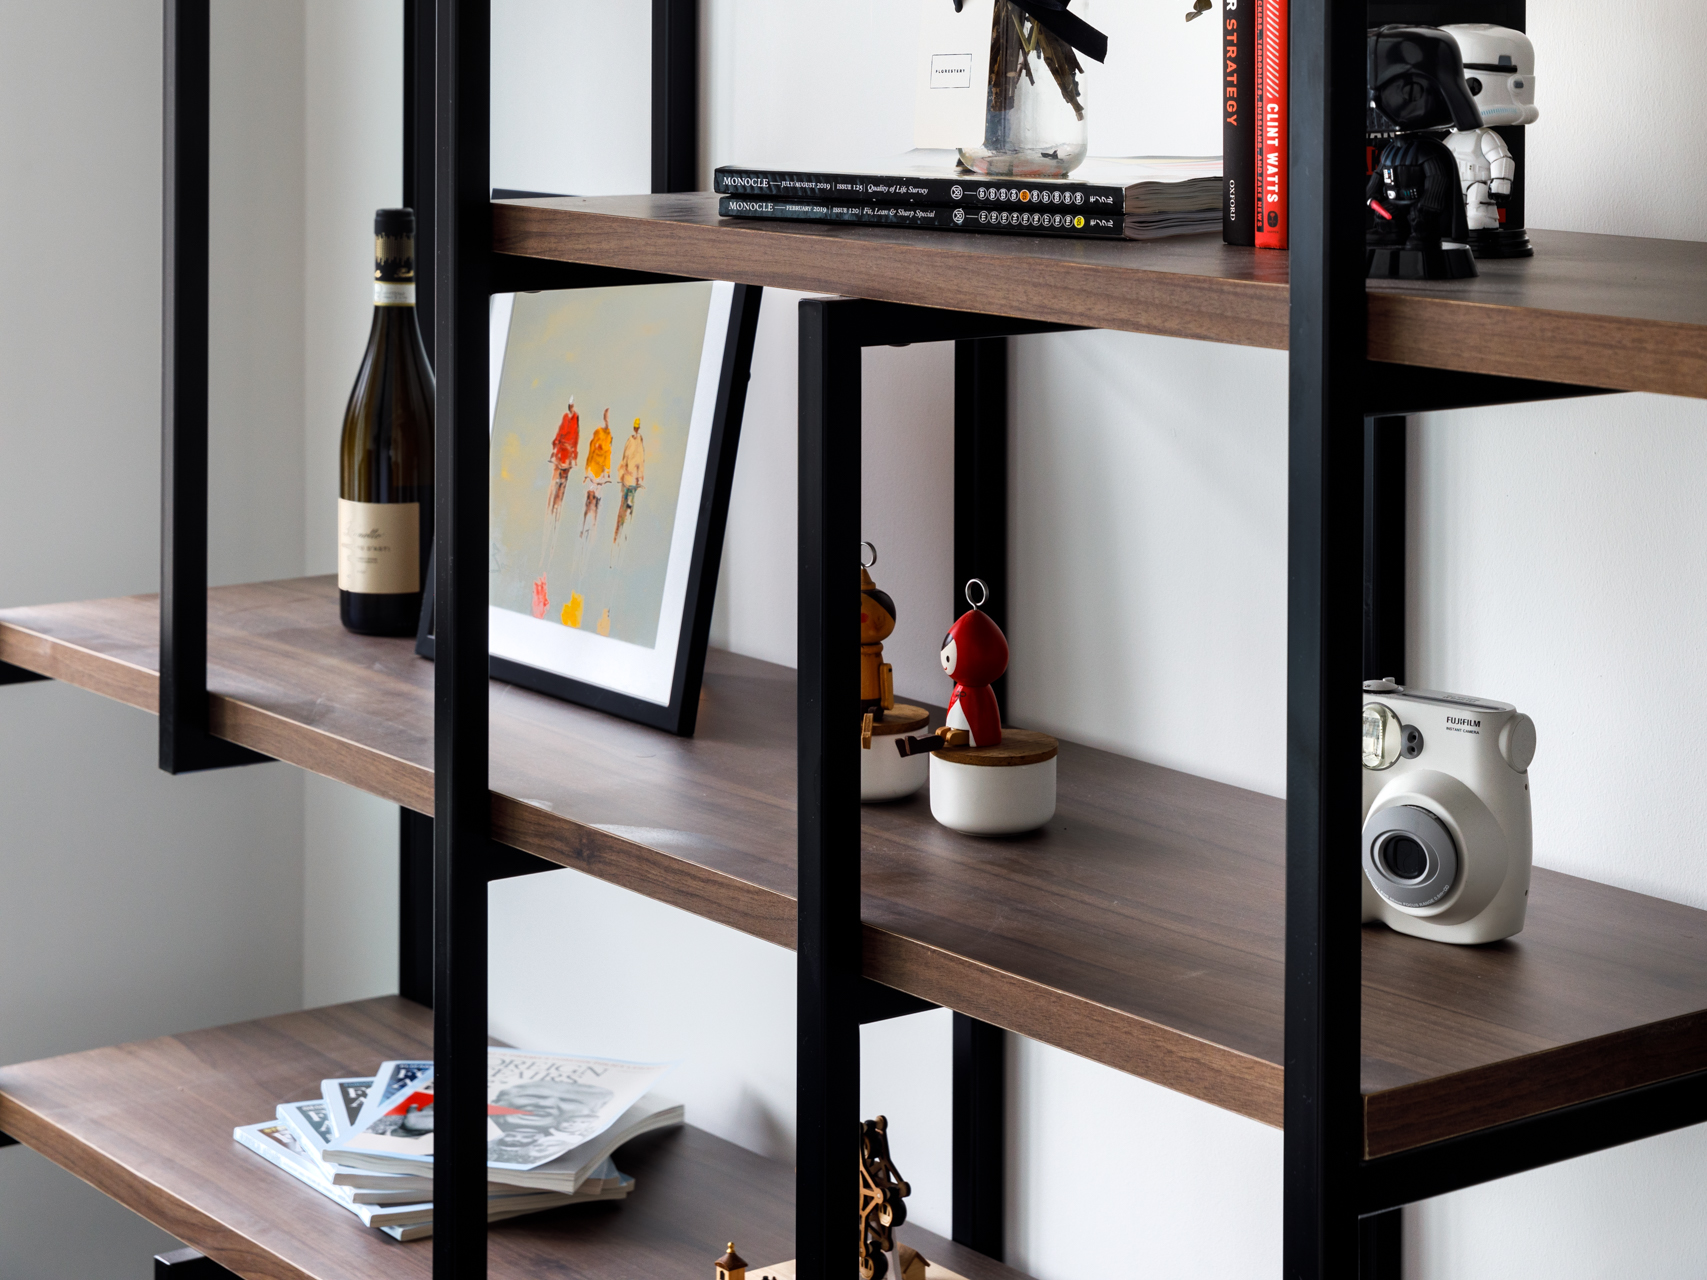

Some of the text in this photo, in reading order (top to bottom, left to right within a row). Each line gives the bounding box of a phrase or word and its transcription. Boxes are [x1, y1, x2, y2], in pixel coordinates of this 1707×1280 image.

[1226, 18, 1238, 126] STRATEGY
[1266, 103, 1279, 147] CLINT
[722, 176, 769, 188] MONOCLE
[817, 182, 831, 190] 2019
[853, 184, 863, 192] 125
[867, 184, 889, 194] Quality
[889, 185, 896, 194] of
[896, 185, 908, 194] Life
[908, 186, 928, 195] Survey
[1266, 152, 1279, 203] WATTS
[1089, 195, 1114, 204] モノクル
[728, 201, 774, 212] MONOCLE
[863, 207, 874, 216] Fit,
[897, 209, 914, 218] Sharp
[915, 209, 936, 218] Special
[1090, 218, 1114, 228] モノクル
[1446, 716, 1481, 728] FUJIFILM
[1420, 899, 1434, 907] RANGE
[490, 1058, 610, 1078] OREIGN
[491, 1066, 579, 1084] FAIRS
